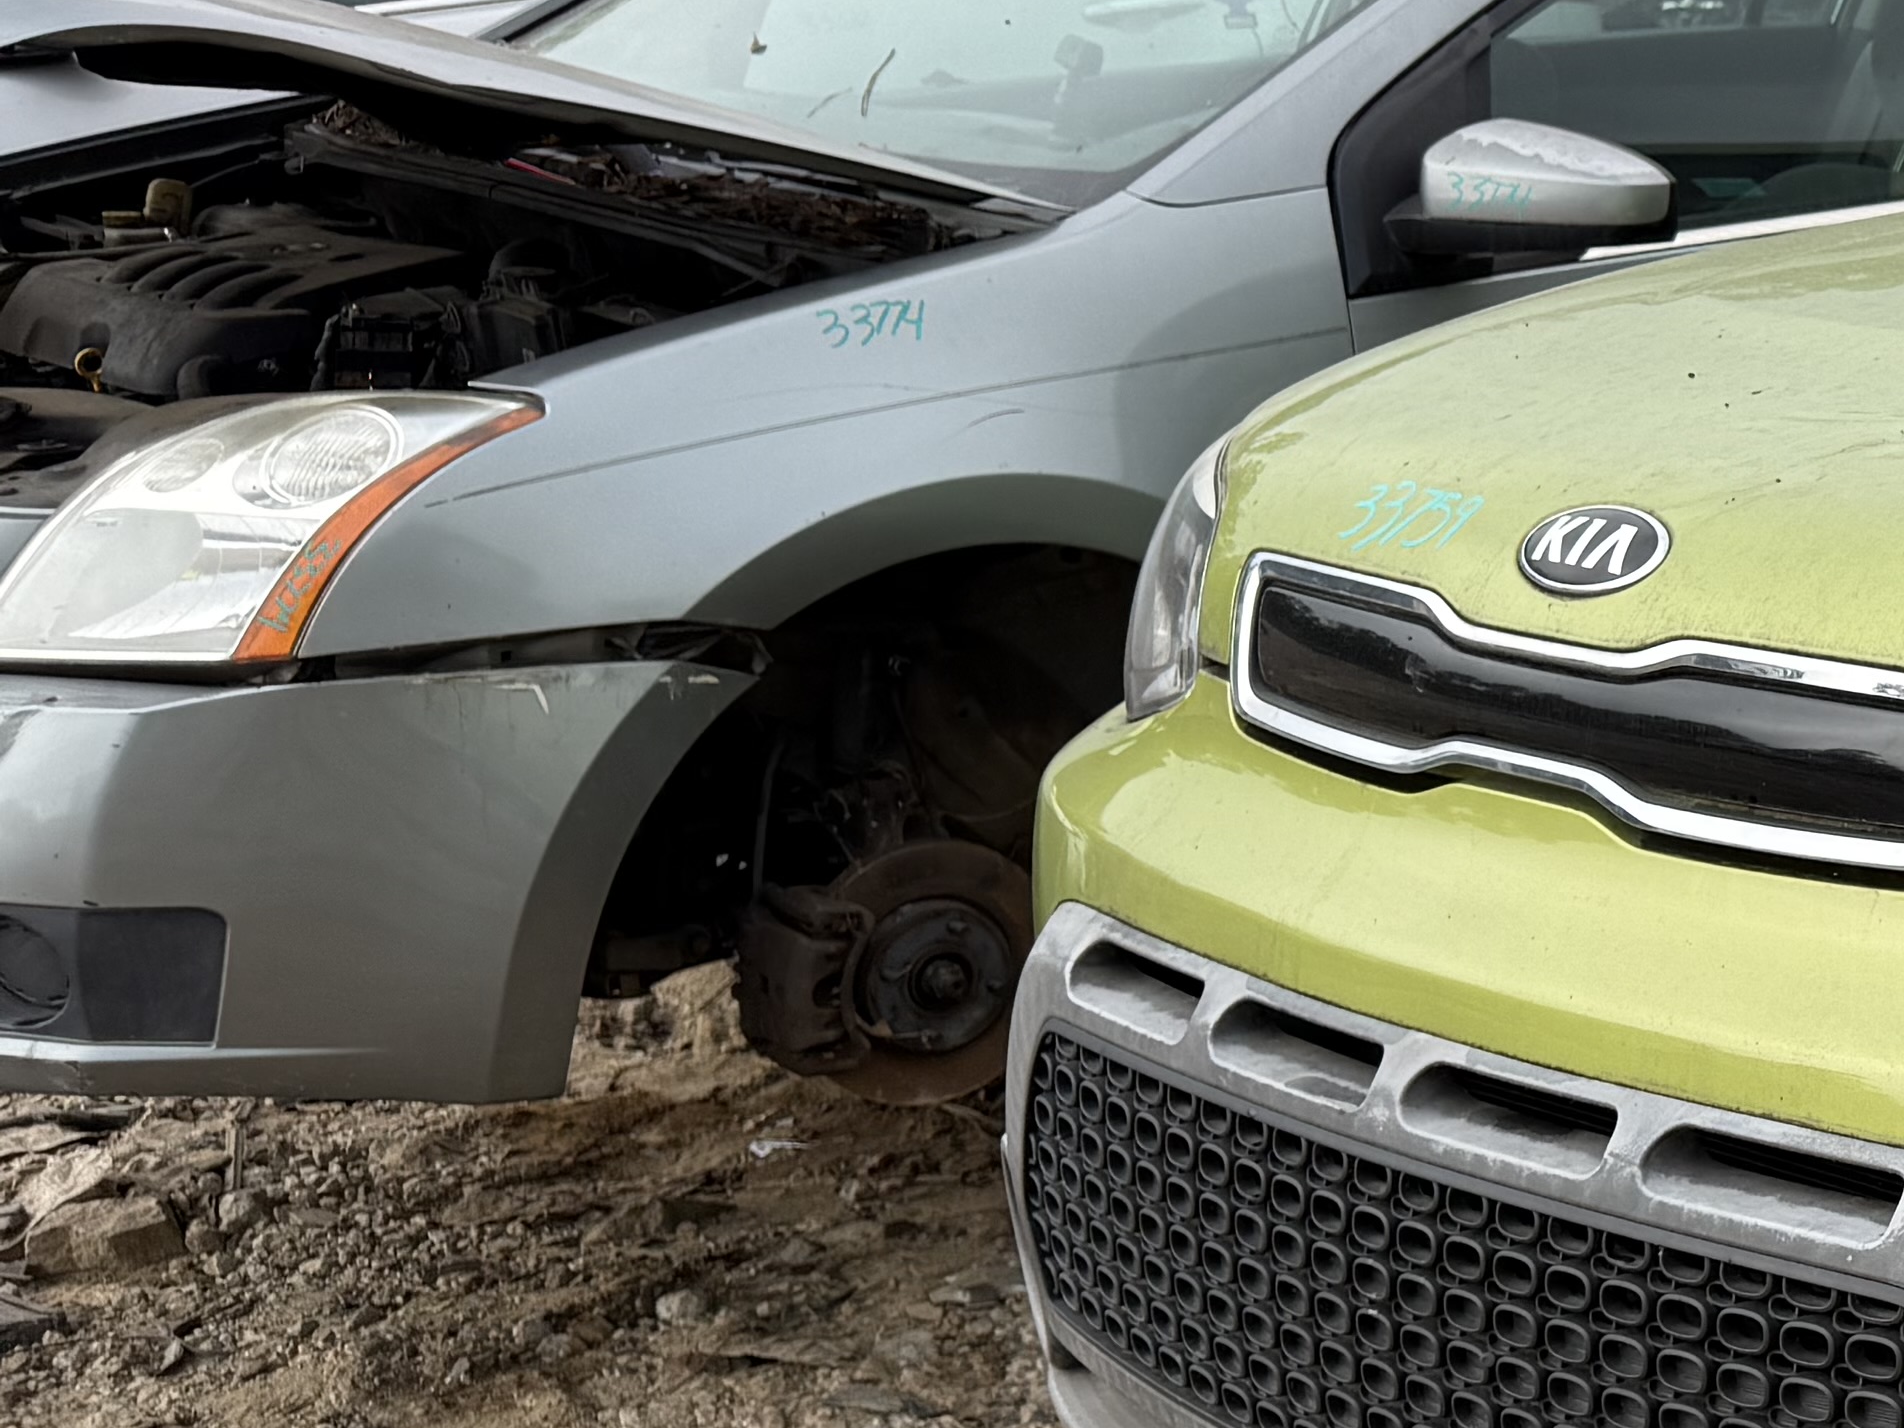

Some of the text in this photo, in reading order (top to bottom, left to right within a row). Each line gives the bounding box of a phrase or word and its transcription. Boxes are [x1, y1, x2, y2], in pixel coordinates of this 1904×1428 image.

[816, 299, 925, 348] 33774
[1338, 480, 1486, 551] 33759
[1530, 515, 1639, 576] KIA
